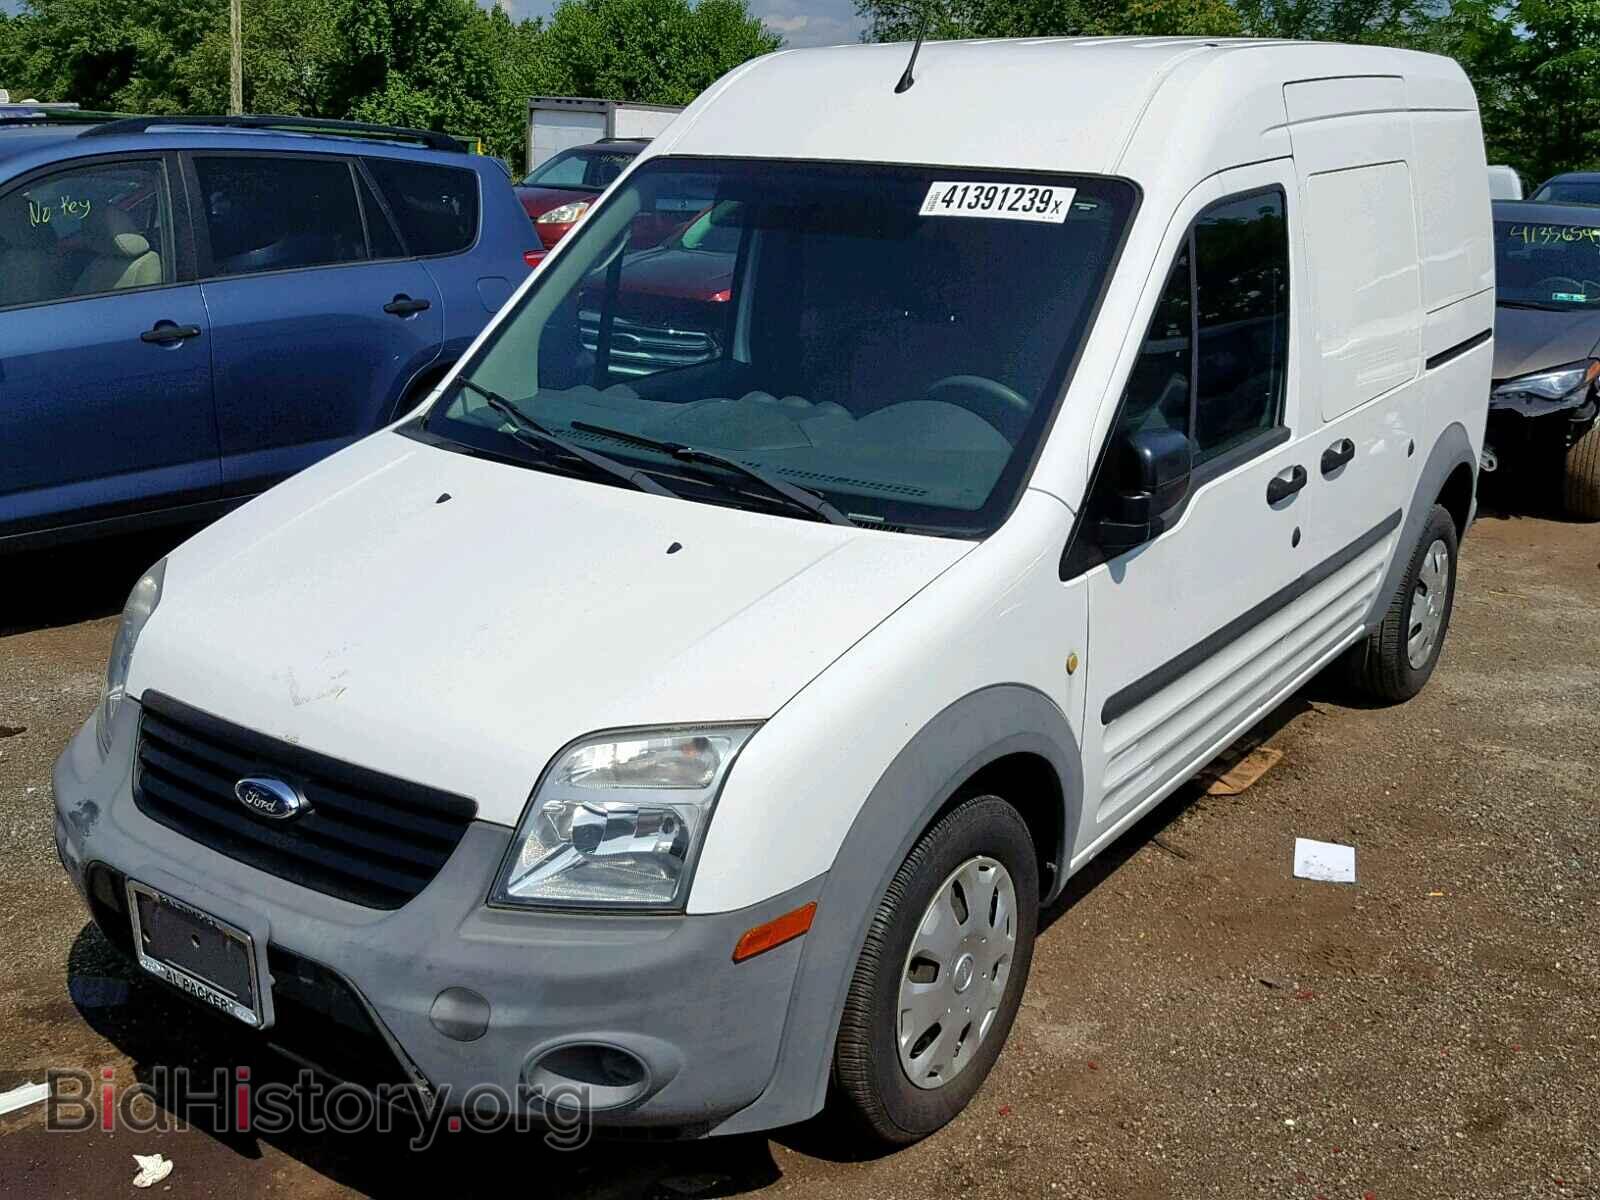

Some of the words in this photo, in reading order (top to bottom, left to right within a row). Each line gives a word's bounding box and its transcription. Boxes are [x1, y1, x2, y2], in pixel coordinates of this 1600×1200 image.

[29, 200, 51, 227] No
[245, 789, 277, 813] Ford
[183, 978, 230, 1014] PACKER
